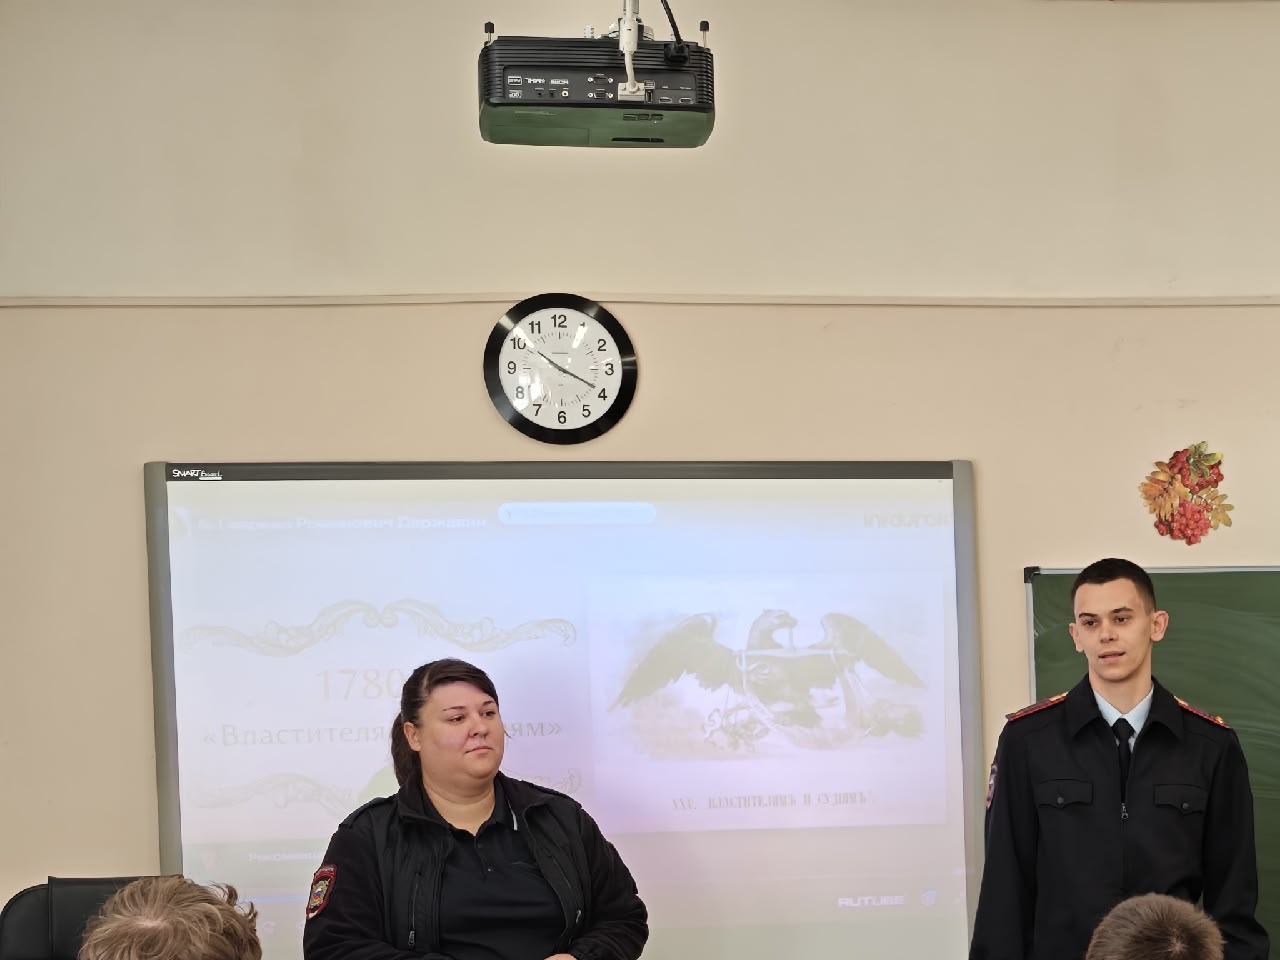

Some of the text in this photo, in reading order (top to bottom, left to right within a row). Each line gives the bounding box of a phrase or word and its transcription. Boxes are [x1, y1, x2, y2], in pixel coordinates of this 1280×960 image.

[529, 321, 541, 334] 11
[551, 315, 567, 328] 12
[510, 338, 526, 350] 10
[598, 339, 606, 351] 2
[507, 361, 517, 374] 9
[605, 363, 614, 375] 3
[516, 386, 525, 399] 8
[598, 388, 607, 401] 4
[533, 404, 542, 416] 7
[582, 405, 591, 417] 5
[558, 411, 567, 424] 6
[172, 469, 201, 478] SMART
[201, 723, 386, 746] «Властителя
